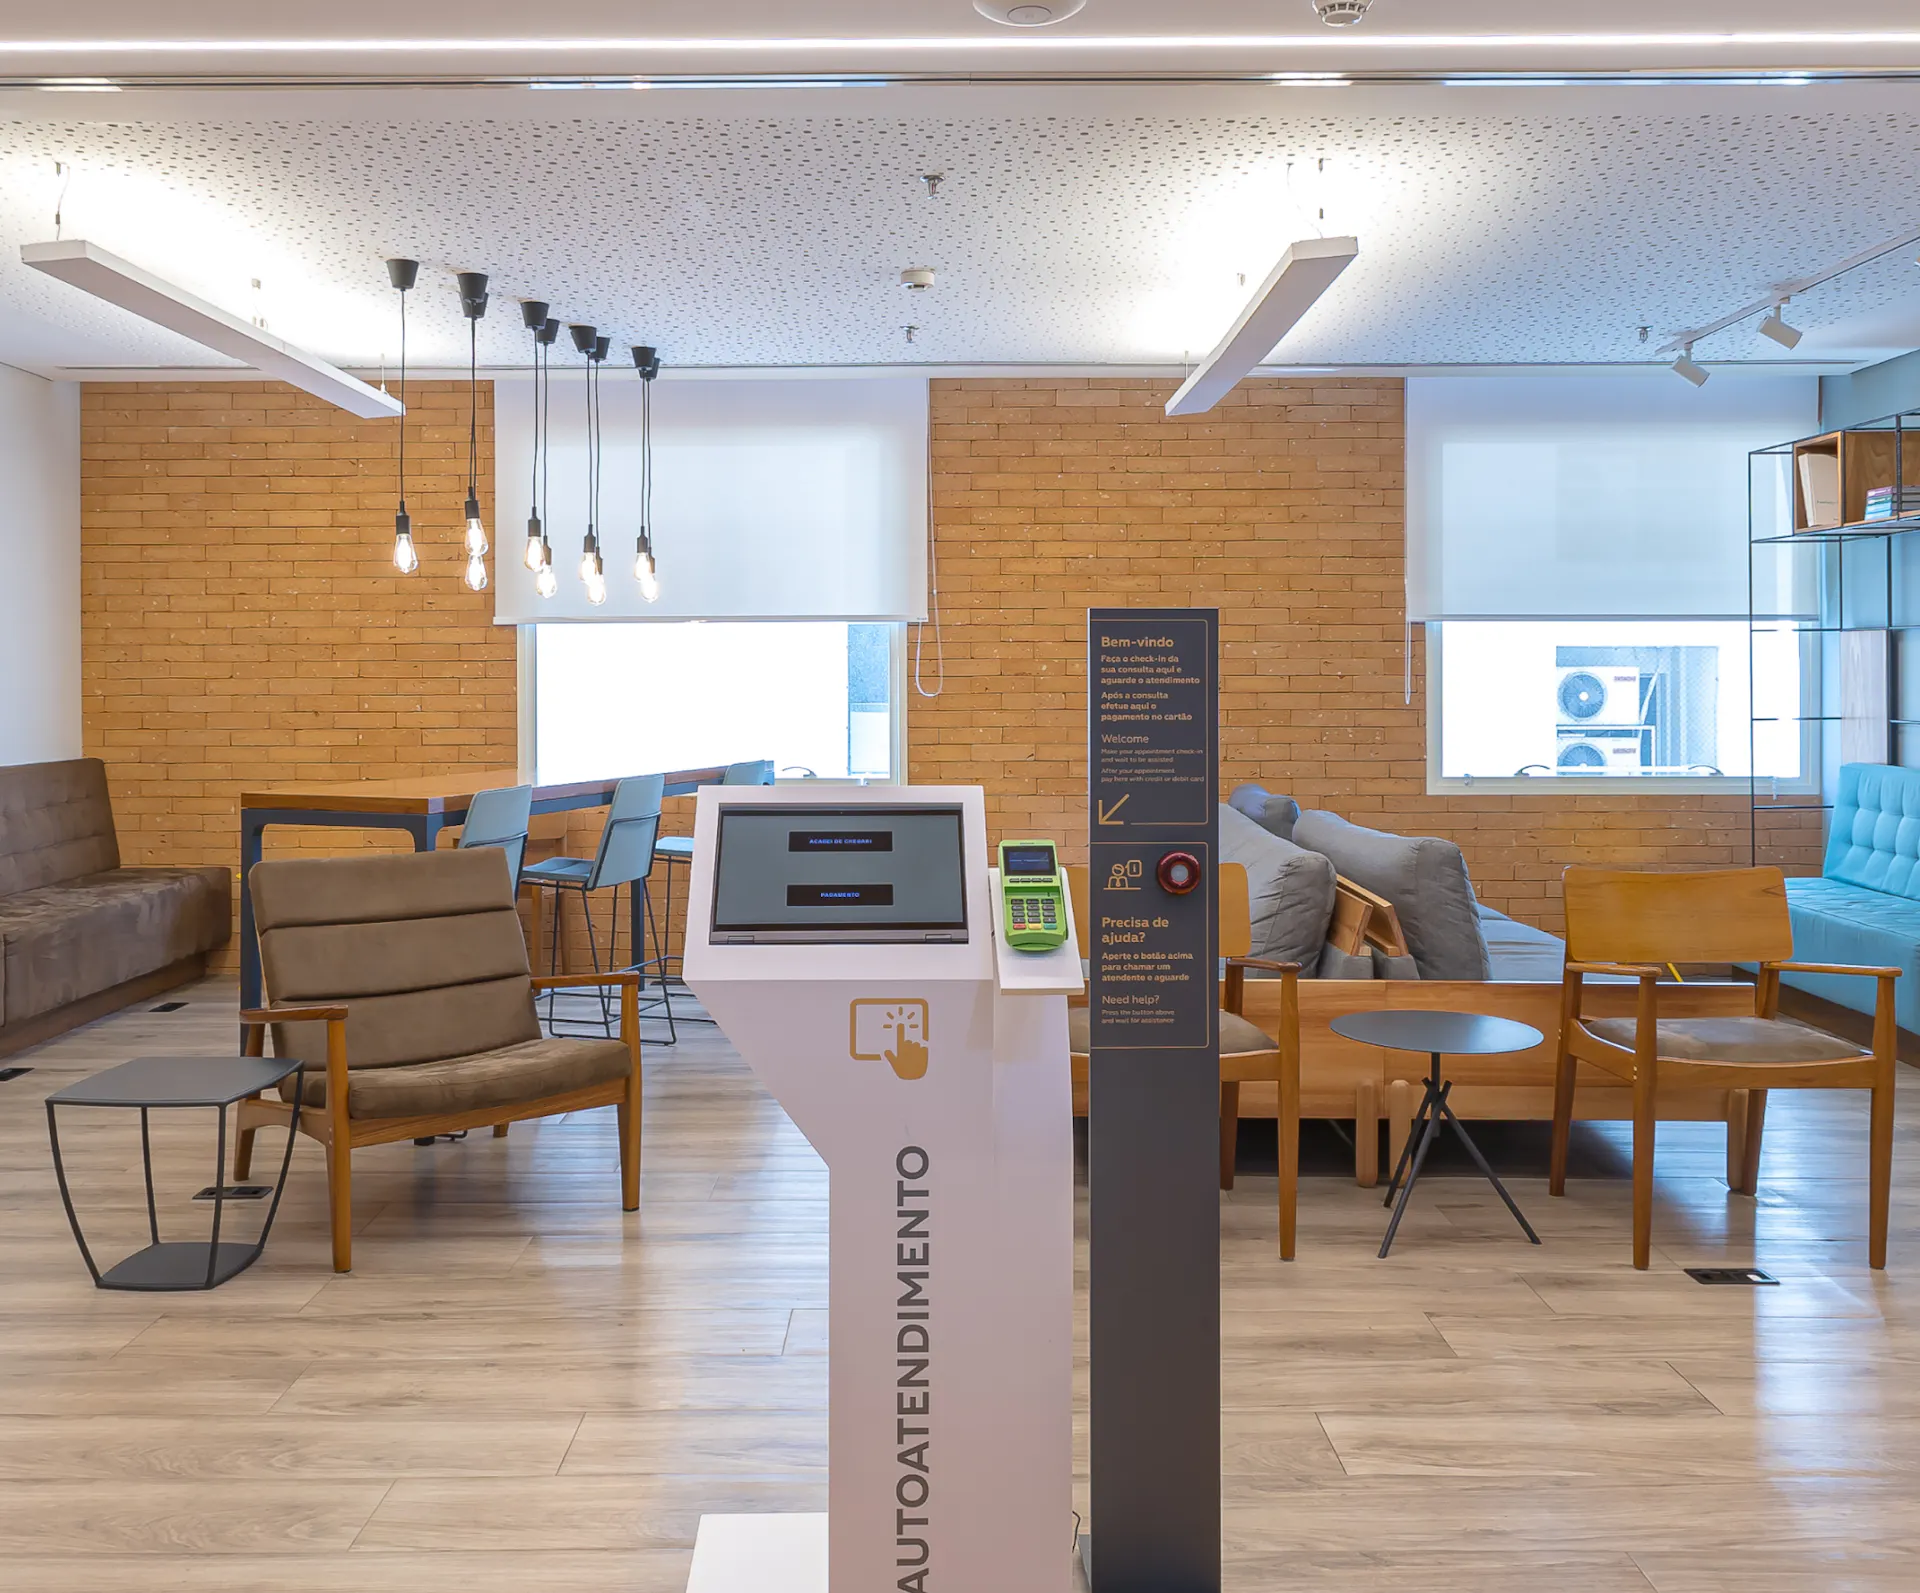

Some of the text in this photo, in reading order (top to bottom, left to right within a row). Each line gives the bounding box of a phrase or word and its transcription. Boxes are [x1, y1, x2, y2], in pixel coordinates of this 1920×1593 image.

[1101, 636, 1174, 647] Bem-vindo
[1101, 655, 1121, 663] Faça
[1156, 666, 1174, 674] aqui
[1101, 677, 1136, 685] aguarde
[1101, 692, 1123, 700] Após
[1130, 703, 1149, 711] aqui
[1101, 714, 1149, 722] pagamento
[1101, 734, 1149, 743] Welcome
[1102, 917, 1169, 928] Precisa de
[1102, 931, 1146, 945] ajuda?
[1102, 952, 1131, 961] Aperte
[1155, 974, 1189, 983] aguarde
[1102, 995, 1159, 1006] Need help?
[896, 1145, 930, 1593] AUTOATENDIMENTO
